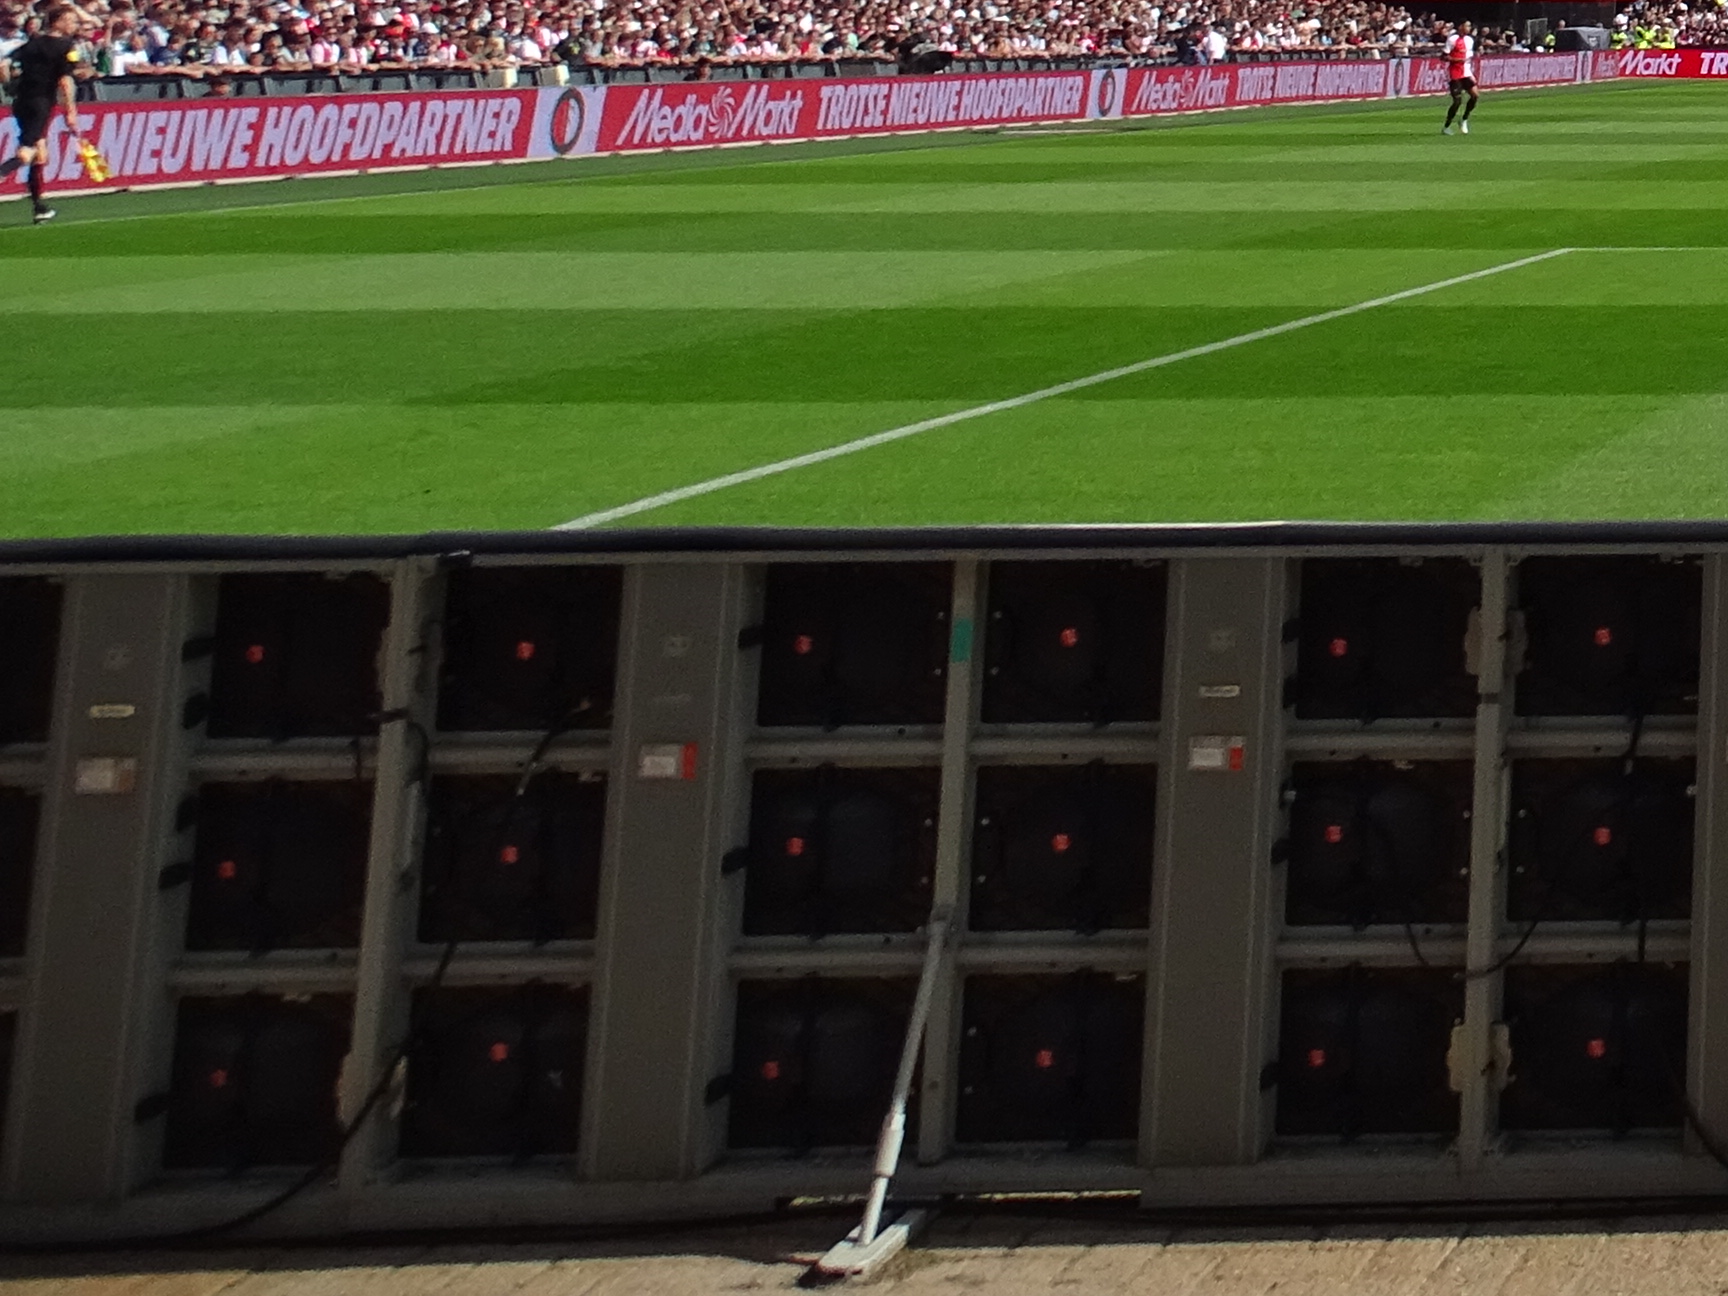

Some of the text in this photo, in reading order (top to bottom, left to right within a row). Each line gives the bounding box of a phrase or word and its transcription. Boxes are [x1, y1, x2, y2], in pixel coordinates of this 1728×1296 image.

[817, 75, 1084, 130] TROTSE NIEUWE HOOFDPARTNER
[97, 107, 260, 177] NIEUWE
[255, 97, 522, 167] HOOFDPARTNER
